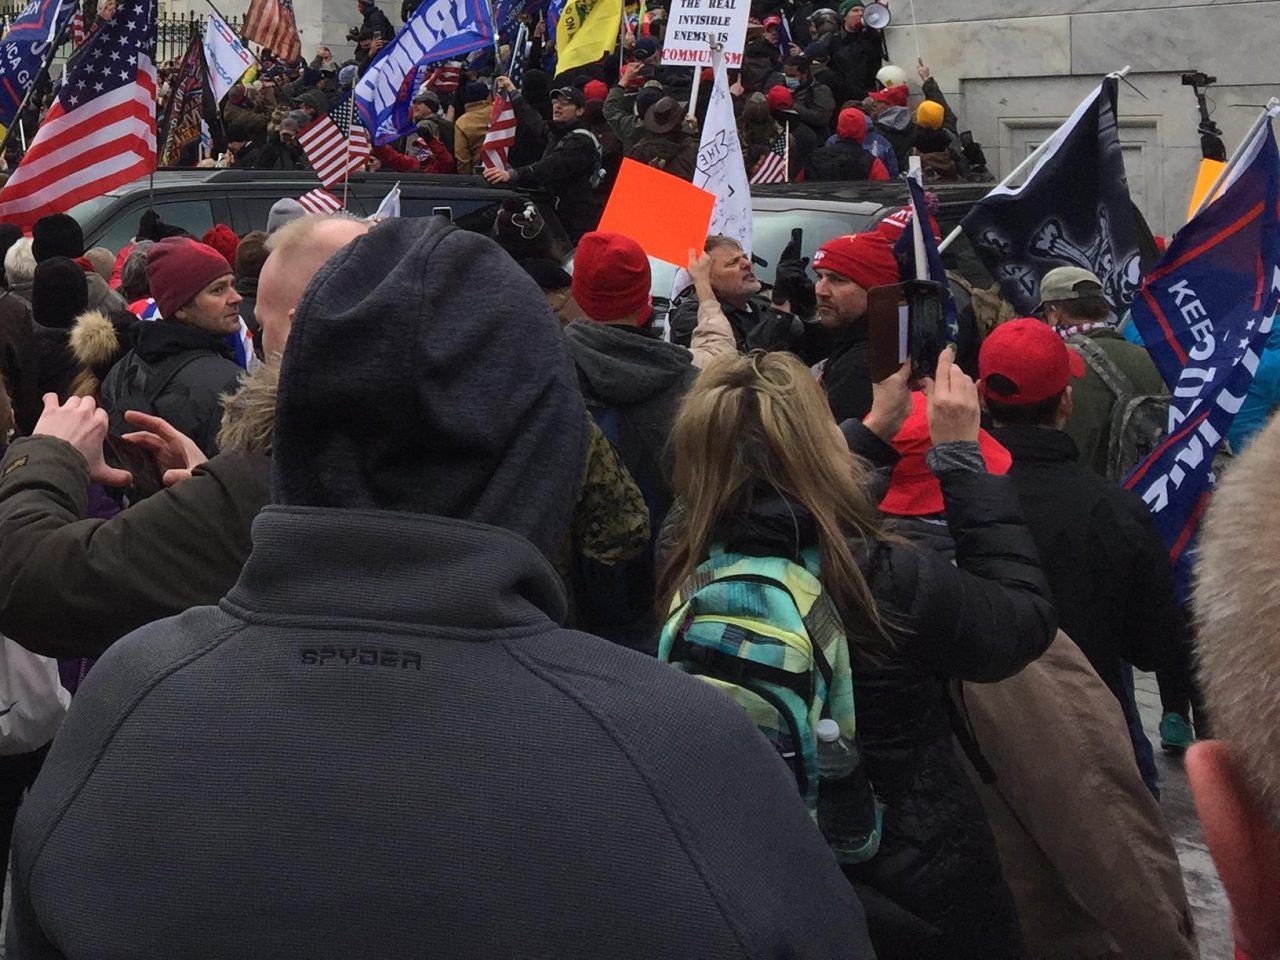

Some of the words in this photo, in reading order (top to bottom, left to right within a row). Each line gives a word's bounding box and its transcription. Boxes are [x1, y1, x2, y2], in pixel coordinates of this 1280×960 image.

[681, 0, 700, 9] THE
[708, 0, 736, 9] REAL
[678, 14, 731, 26] INVISIBLE
[674, 31, 707, 41] ENEMY
[718, 33, 729, 43] IS
[661, 48, 742, 65] COMMUSM
[301, 647, 422, 671] SPYDER
